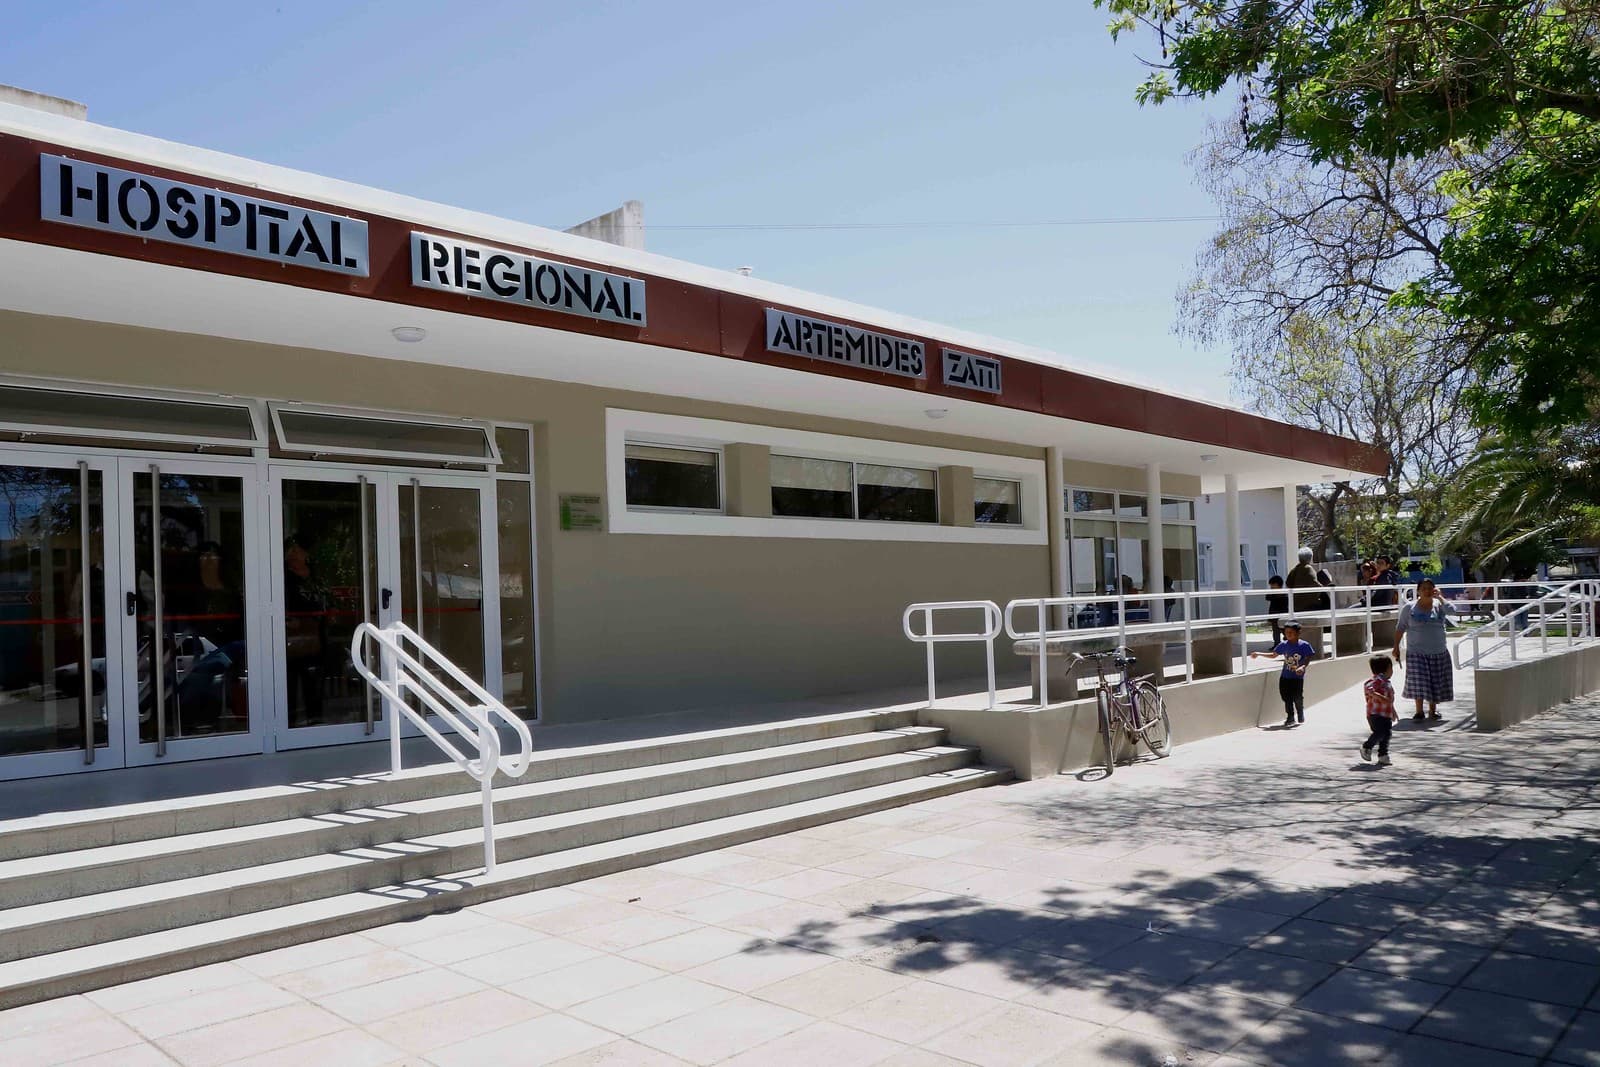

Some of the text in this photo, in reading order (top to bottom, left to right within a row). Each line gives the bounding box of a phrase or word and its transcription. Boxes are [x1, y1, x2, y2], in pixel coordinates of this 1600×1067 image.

[60, 163, 1000, 390] HOSPITAL REGIONAL ARTEMIDES ZATTI
